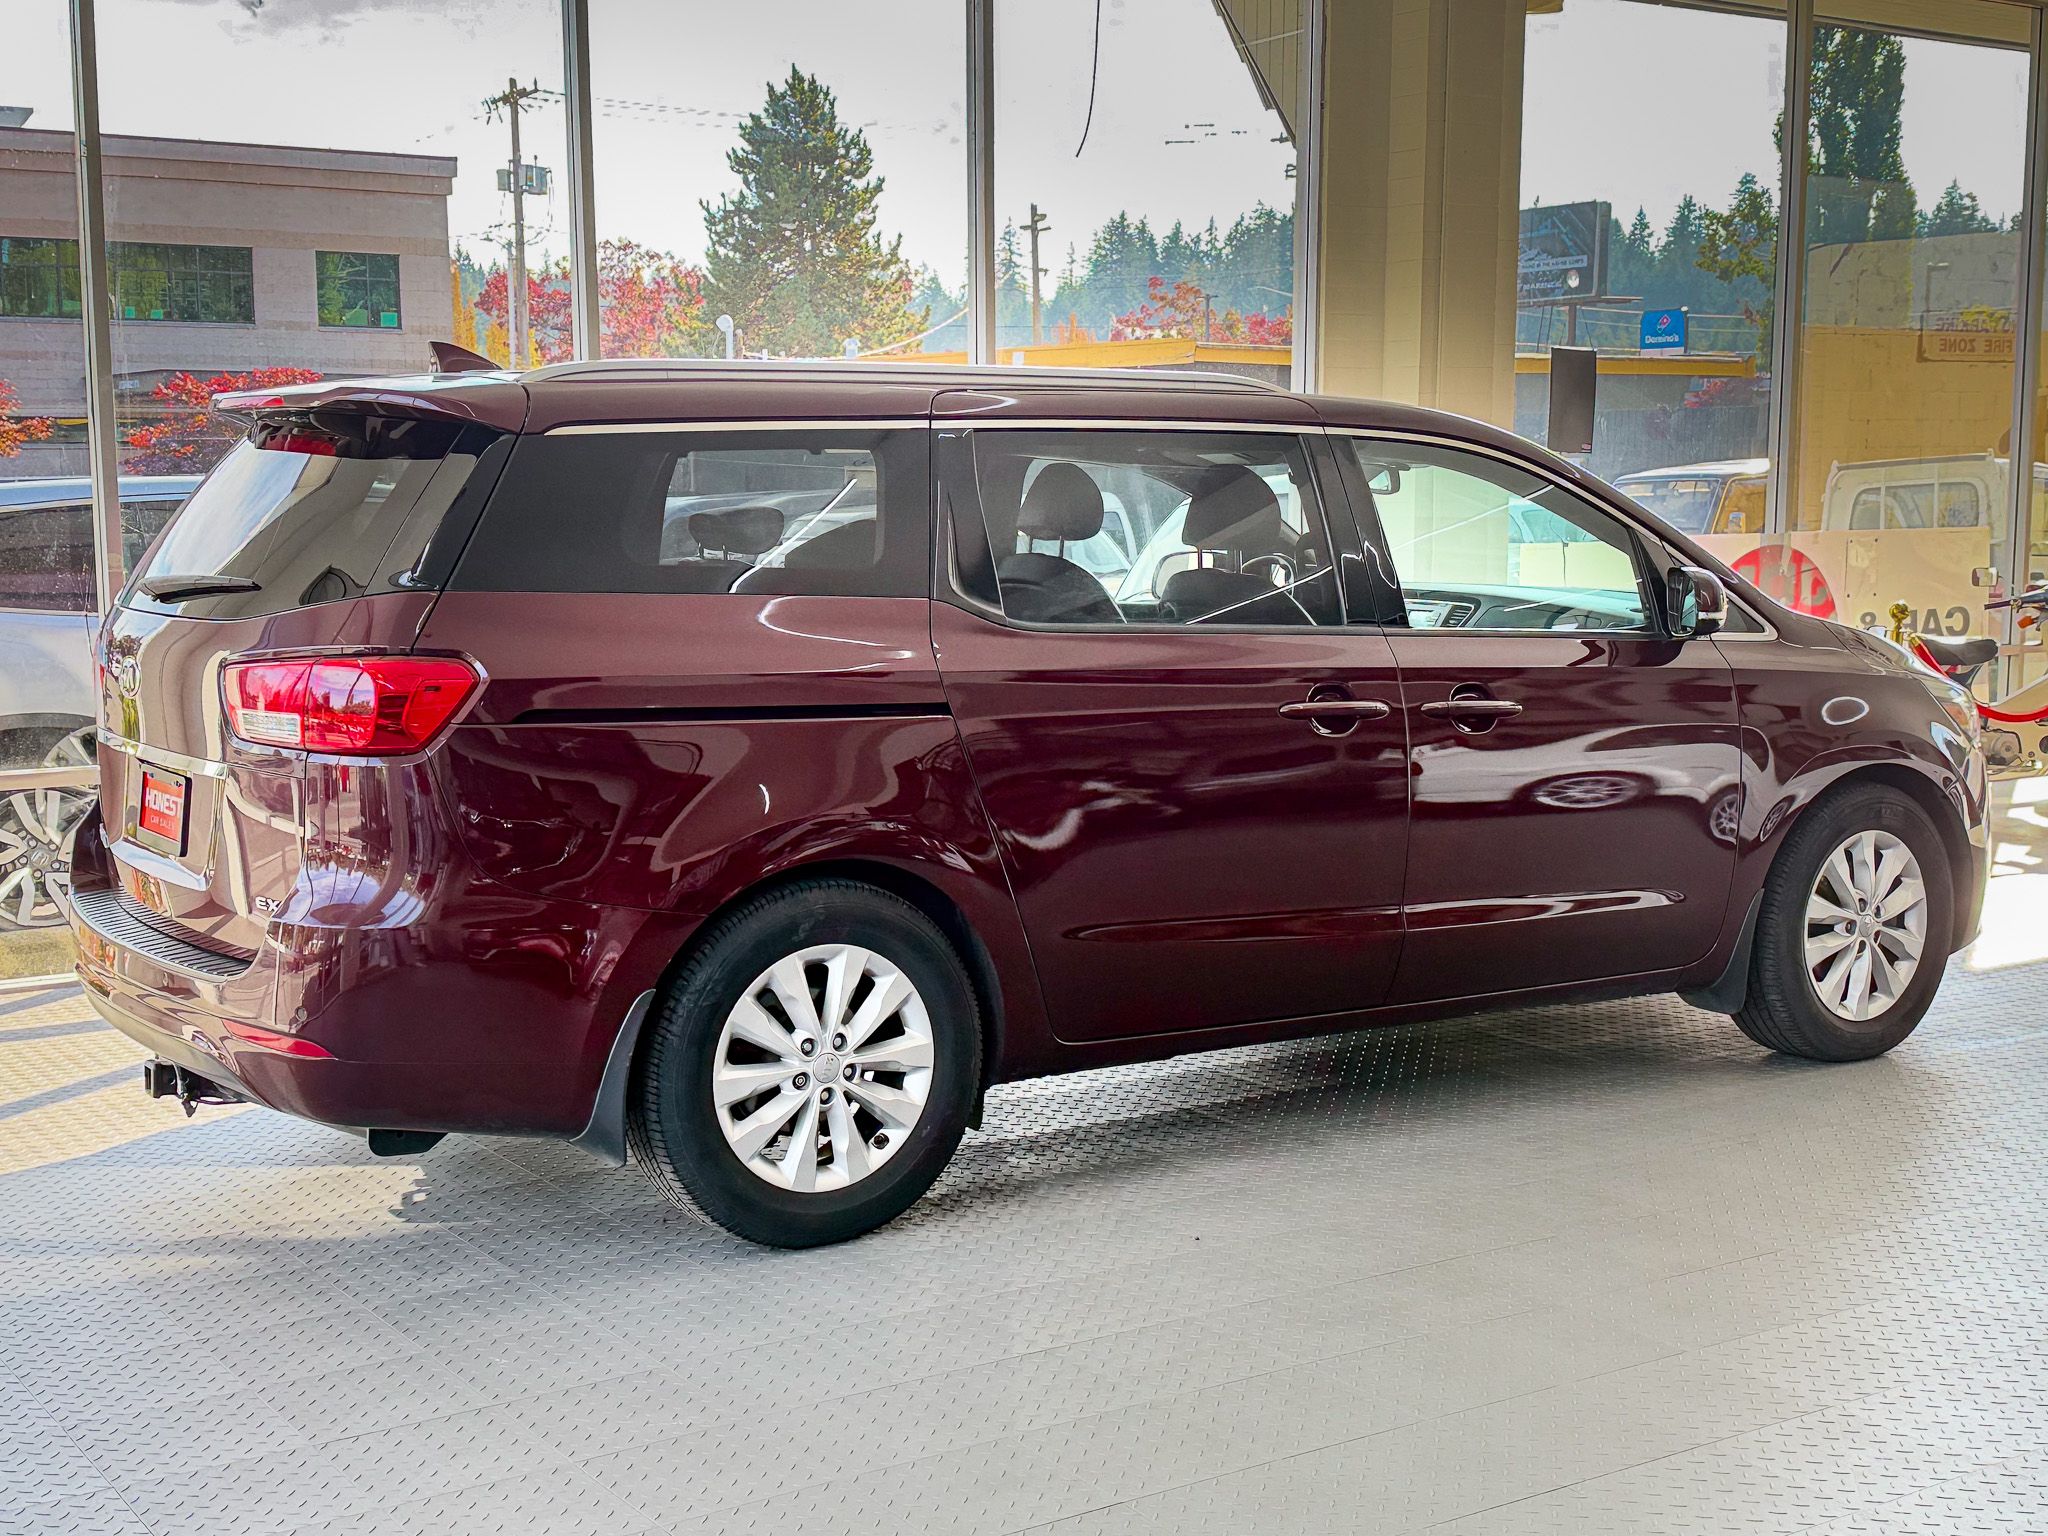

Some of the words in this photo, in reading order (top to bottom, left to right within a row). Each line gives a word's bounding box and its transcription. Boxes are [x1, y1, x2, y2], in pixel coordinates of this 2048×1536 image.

[1645, 333, 1679, 344] Domino's
[145, 787, 181, 818] HONEST
[255, 896, 281, 911] EX
